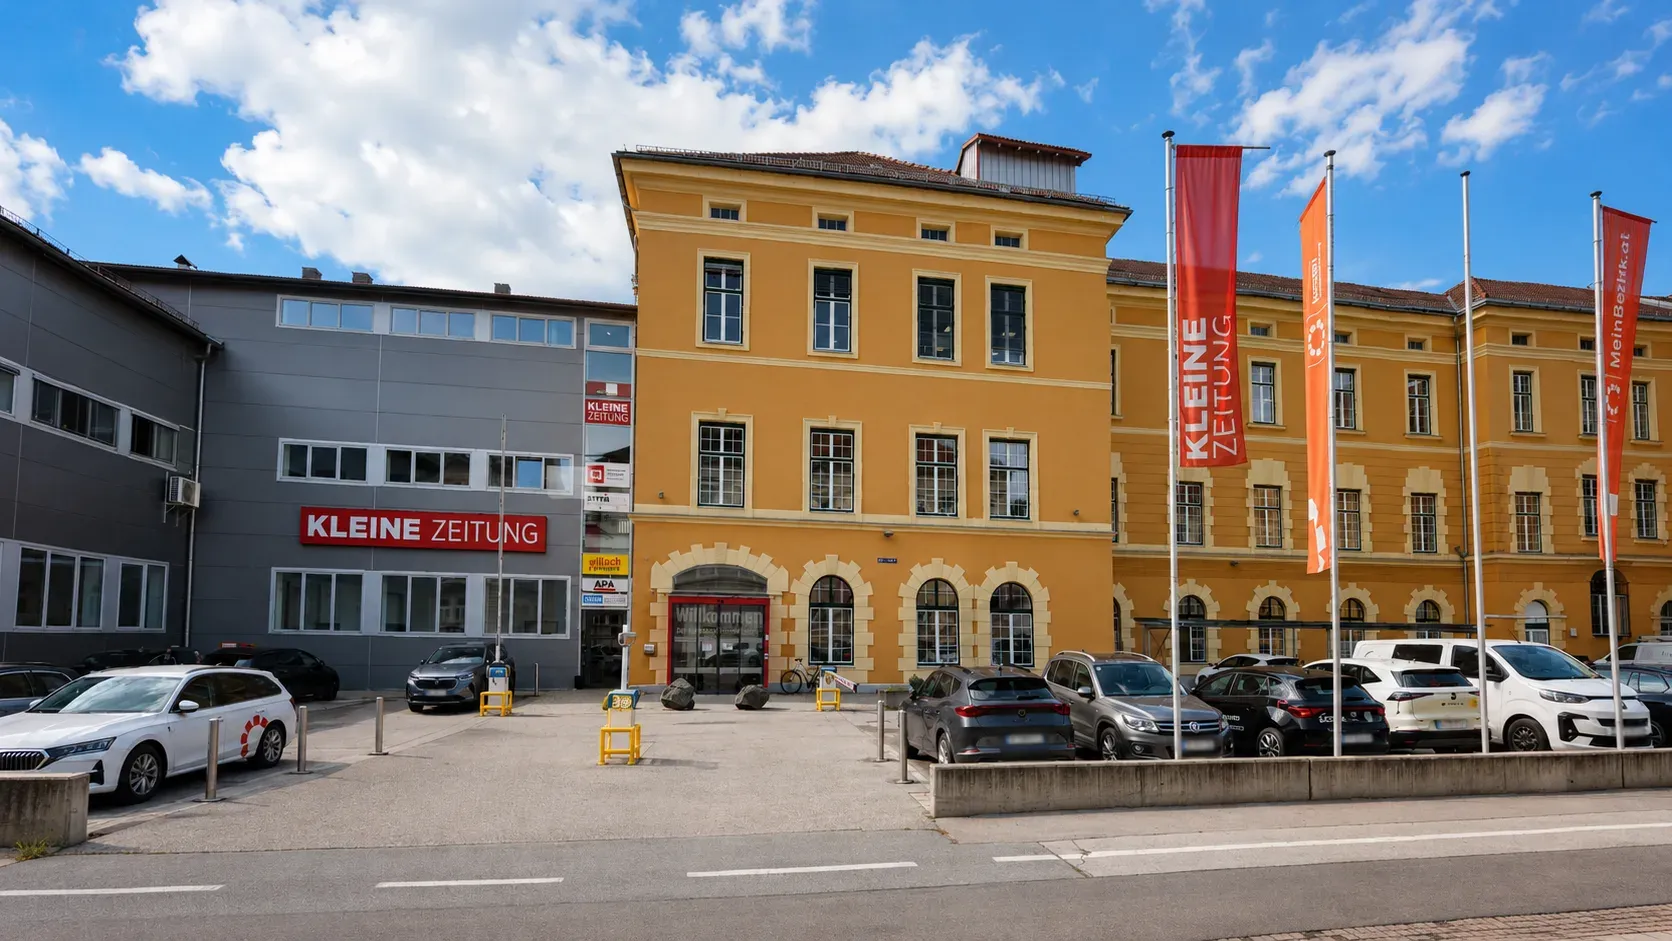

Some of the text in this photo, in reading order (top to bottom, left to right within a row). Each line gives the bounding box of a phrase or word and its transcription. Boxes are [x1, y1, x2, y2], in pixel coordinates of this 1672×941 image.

[1182, 317, 1209, 460] KLEINE
[1212, 315, 1238, 459] ZEITUNG
[587, 401, 628, 413] KLEINE
[587, 411, 629, 423] ZEITUNG
[307, 514, 539, 544] KLEINE ZEITUNG
[594, 579, 615, 588] APA
[676, 605, 764, 625] Willkommen
